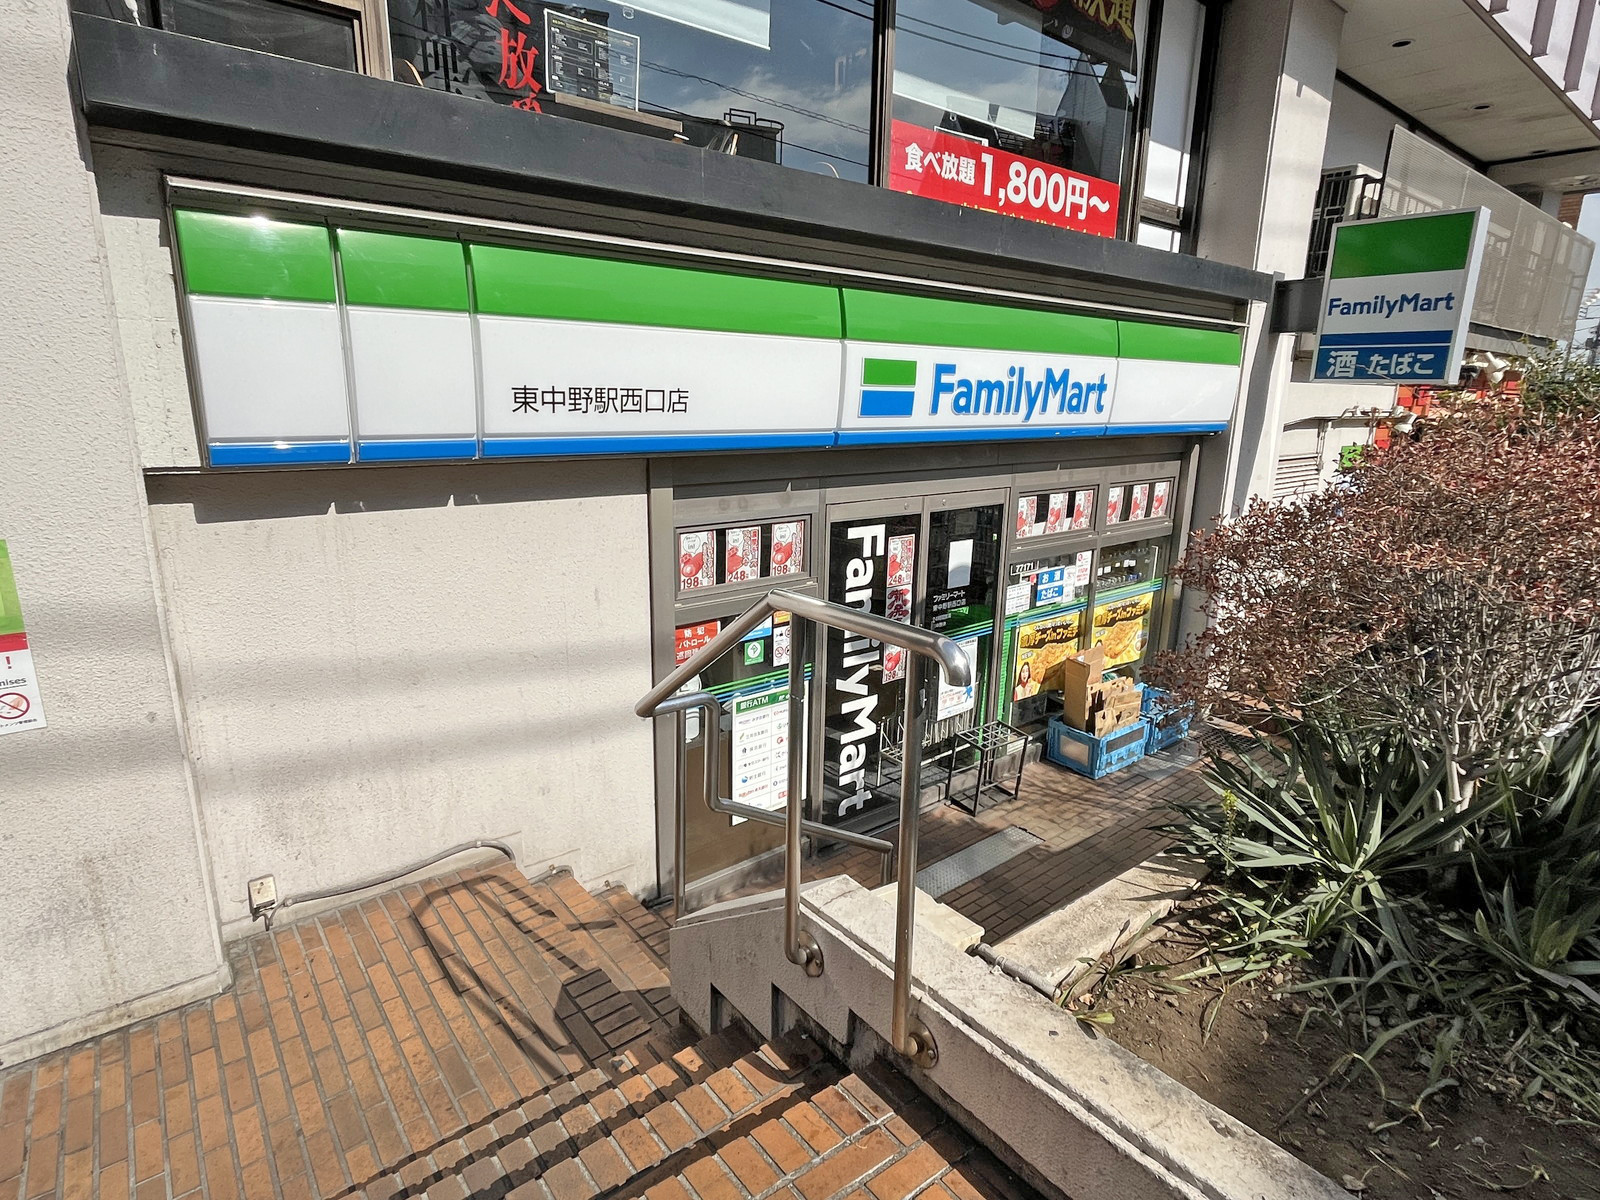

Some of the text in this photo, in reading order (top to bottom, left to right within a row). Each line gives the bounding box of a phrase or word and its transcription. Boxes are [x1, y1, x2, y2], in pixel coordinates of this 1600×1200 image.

[1328, 292, 1455, 318] FamilyMart
[1326, 350, 1435, 378] 酒 たばこ
[929, 362, 1108, 423] FamilyMart
[511, 385, 689, 414] 東中野駅西口店
[728, 570, 746, 582] 248
[772, 564, 788, 576] 198
[682, 577, 699, 589] 198
[888, 574, 902, 586] 248
[933, 590, 966, 603] ファミリーマート
[1040, 587, 1059, 600] たばこ
[679, 635, 711, 649] パトロール
[835, 524, 886, 818] FamilyMart
[884, 670, 896, 682] 198
